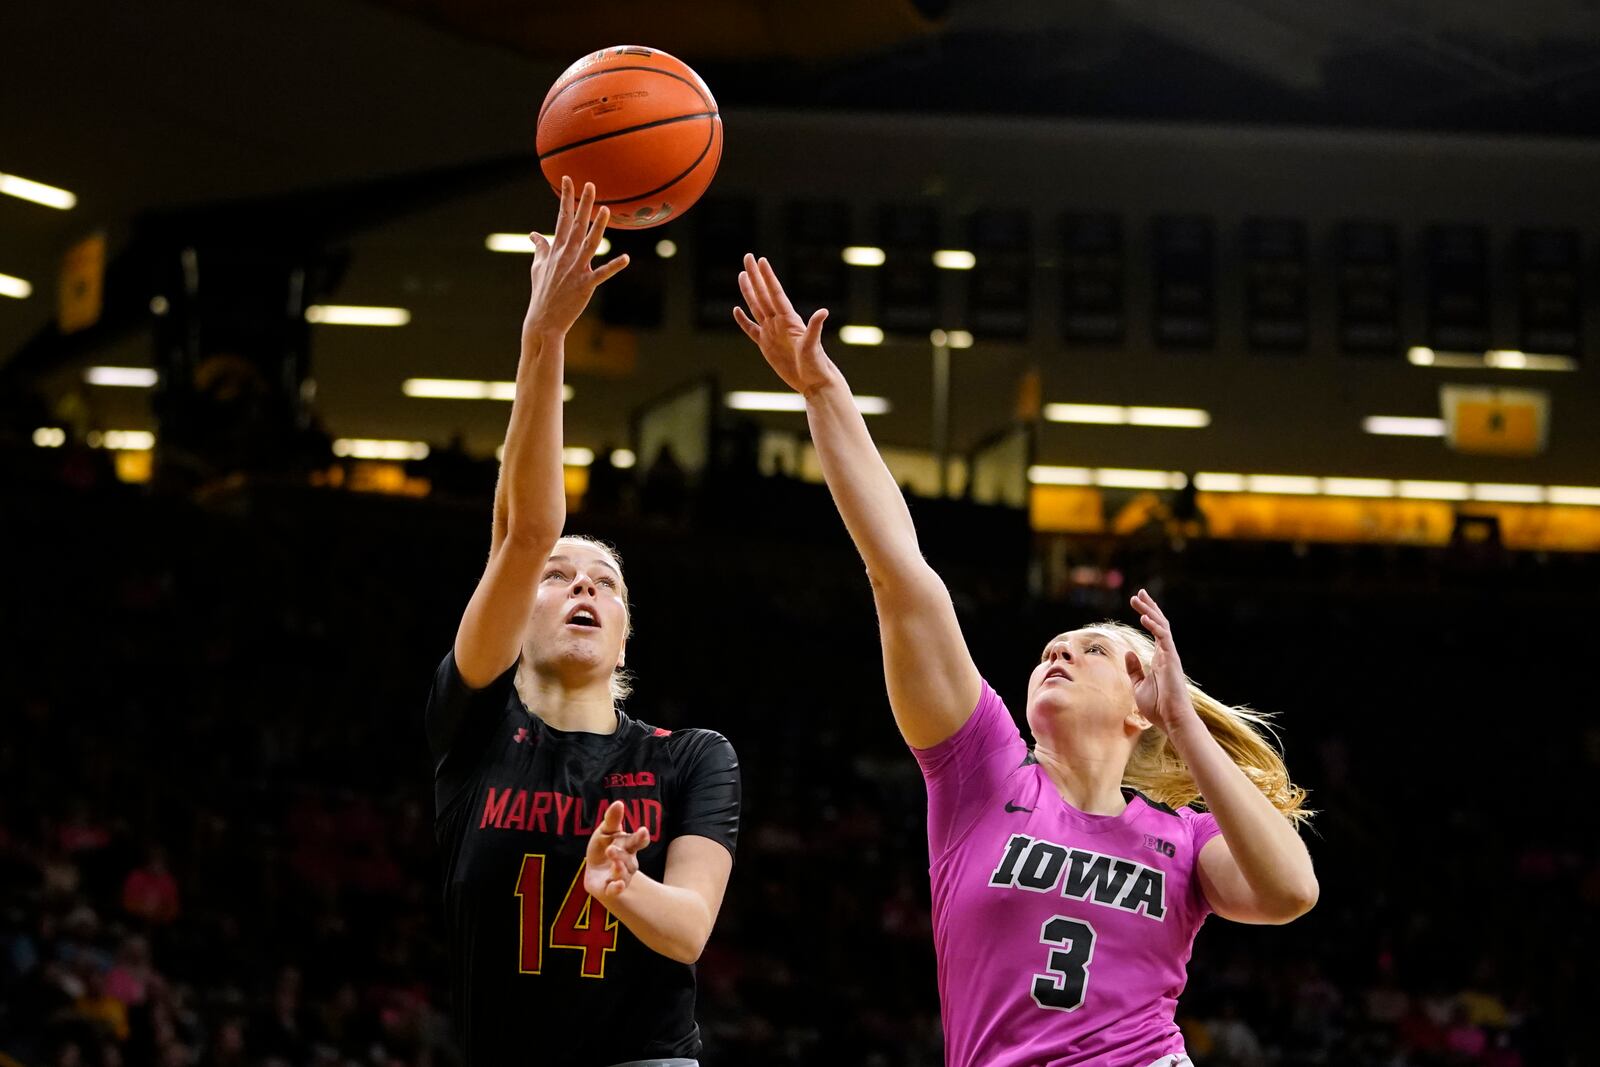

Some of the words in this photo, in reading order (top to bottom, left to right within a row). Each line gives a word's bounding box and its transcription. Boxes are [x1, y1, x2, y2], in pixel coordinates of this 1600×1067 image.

[513, 853, 619, 979] 14
[988, 833, 1167, 922] IOWA
[1031, 914, 1097, 1013] 3
